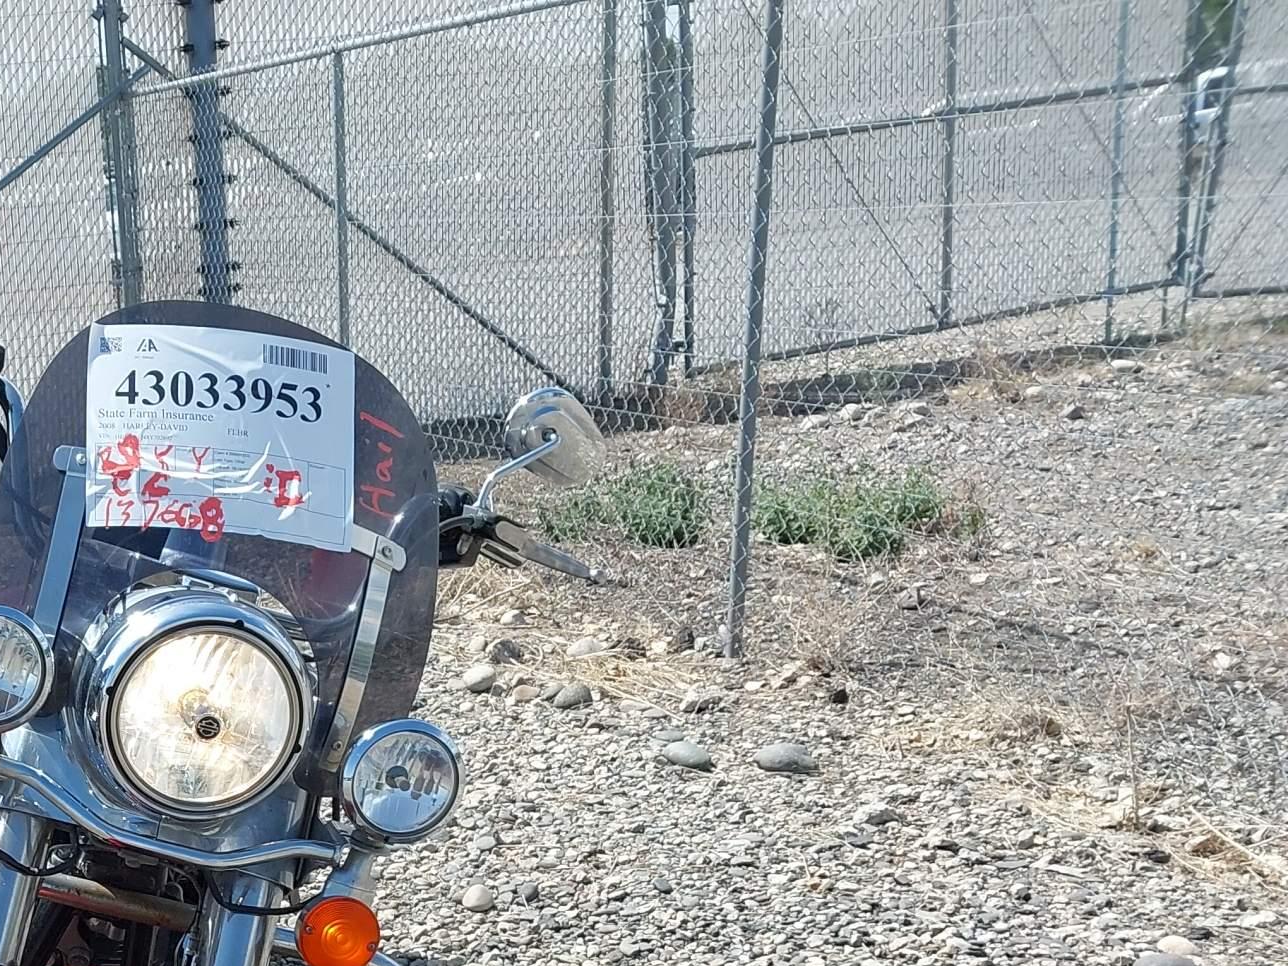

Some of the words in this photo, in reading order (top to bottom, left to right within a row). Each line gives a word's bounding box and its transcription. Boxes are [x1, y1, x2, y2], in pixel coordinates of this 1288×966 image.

[97, 408, 125, 419] State
[128, 408, 158, 420] Farm
[161, 408, 215, 422] Insurance
[226, 427, 249, 438] FLHR
[360, 410, 404, 521] Hail
